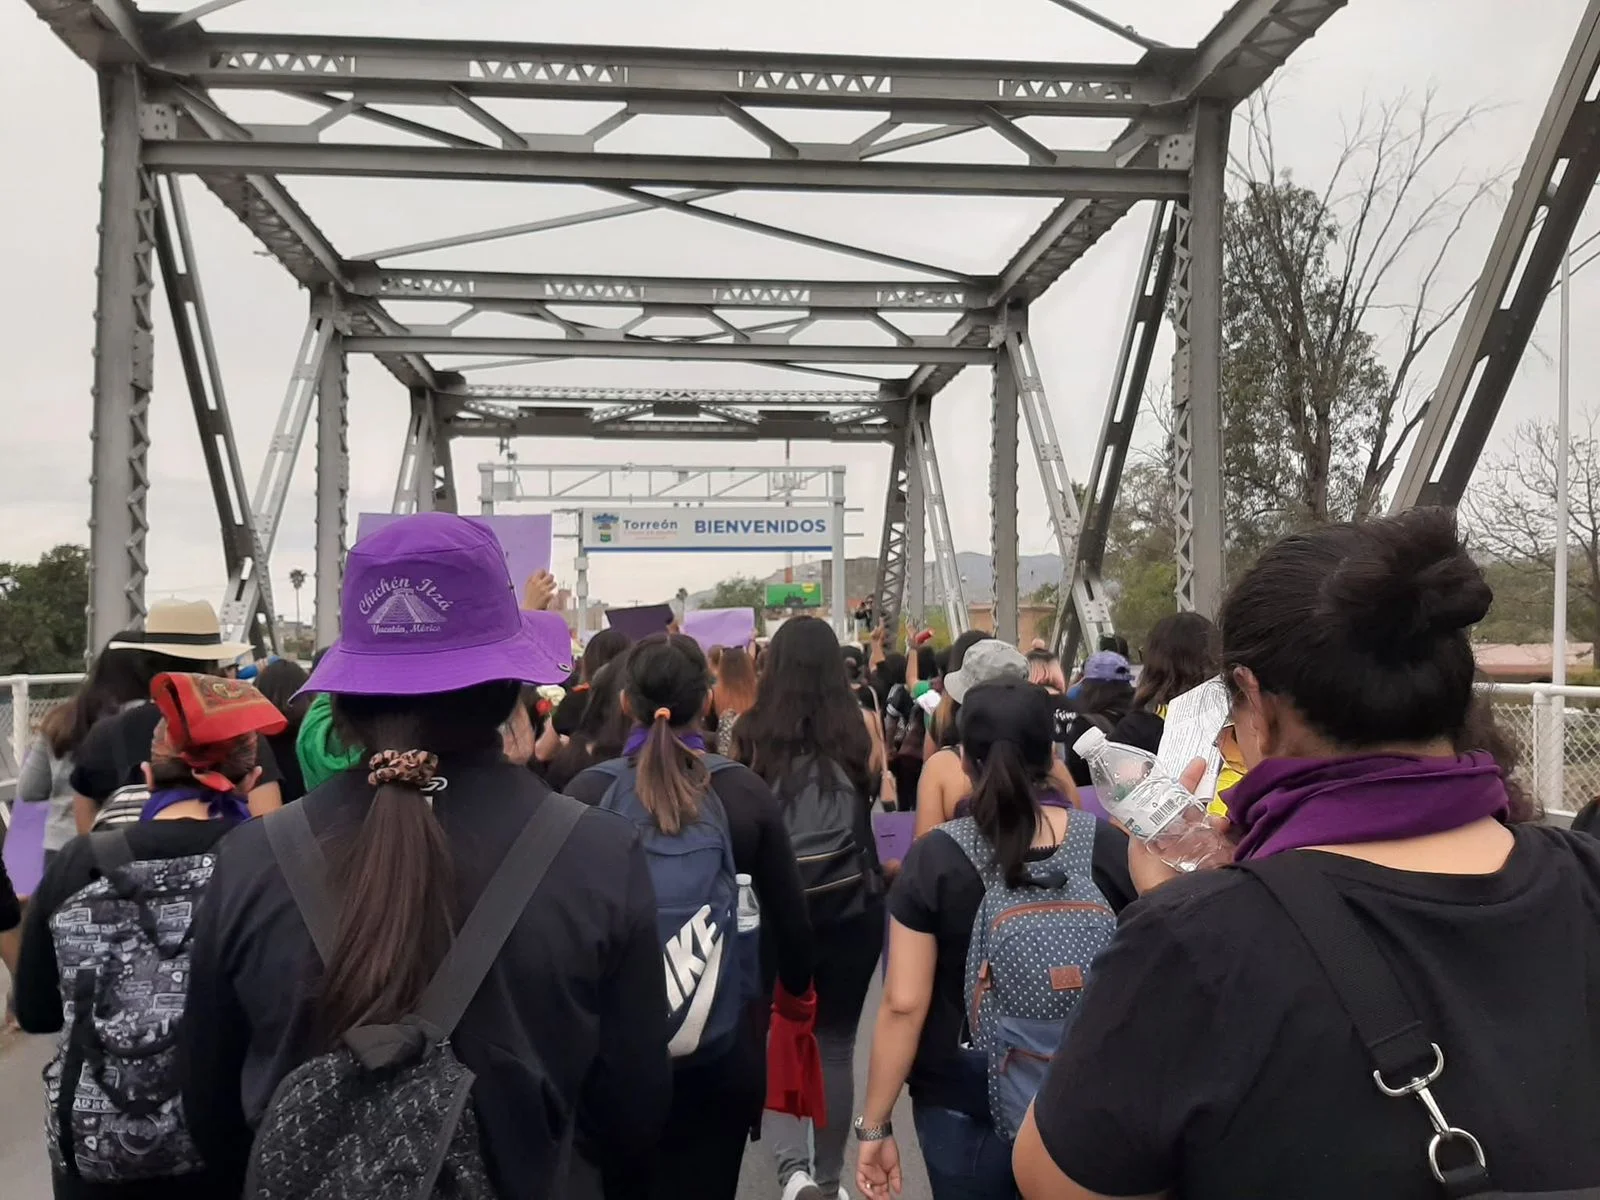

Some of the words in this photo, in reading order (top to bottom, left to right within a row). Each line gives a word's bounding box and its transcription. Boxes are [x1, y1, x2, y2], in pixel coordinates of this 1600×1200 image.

[623, 519, 678, 530] Torreón
[694, 518, 826, 534] BIENVENIDOS
[359, 576, 410, 615] Chichén
[415, 578, 453, 611] Itzá
[663, 904, 718, 1012] IKE
